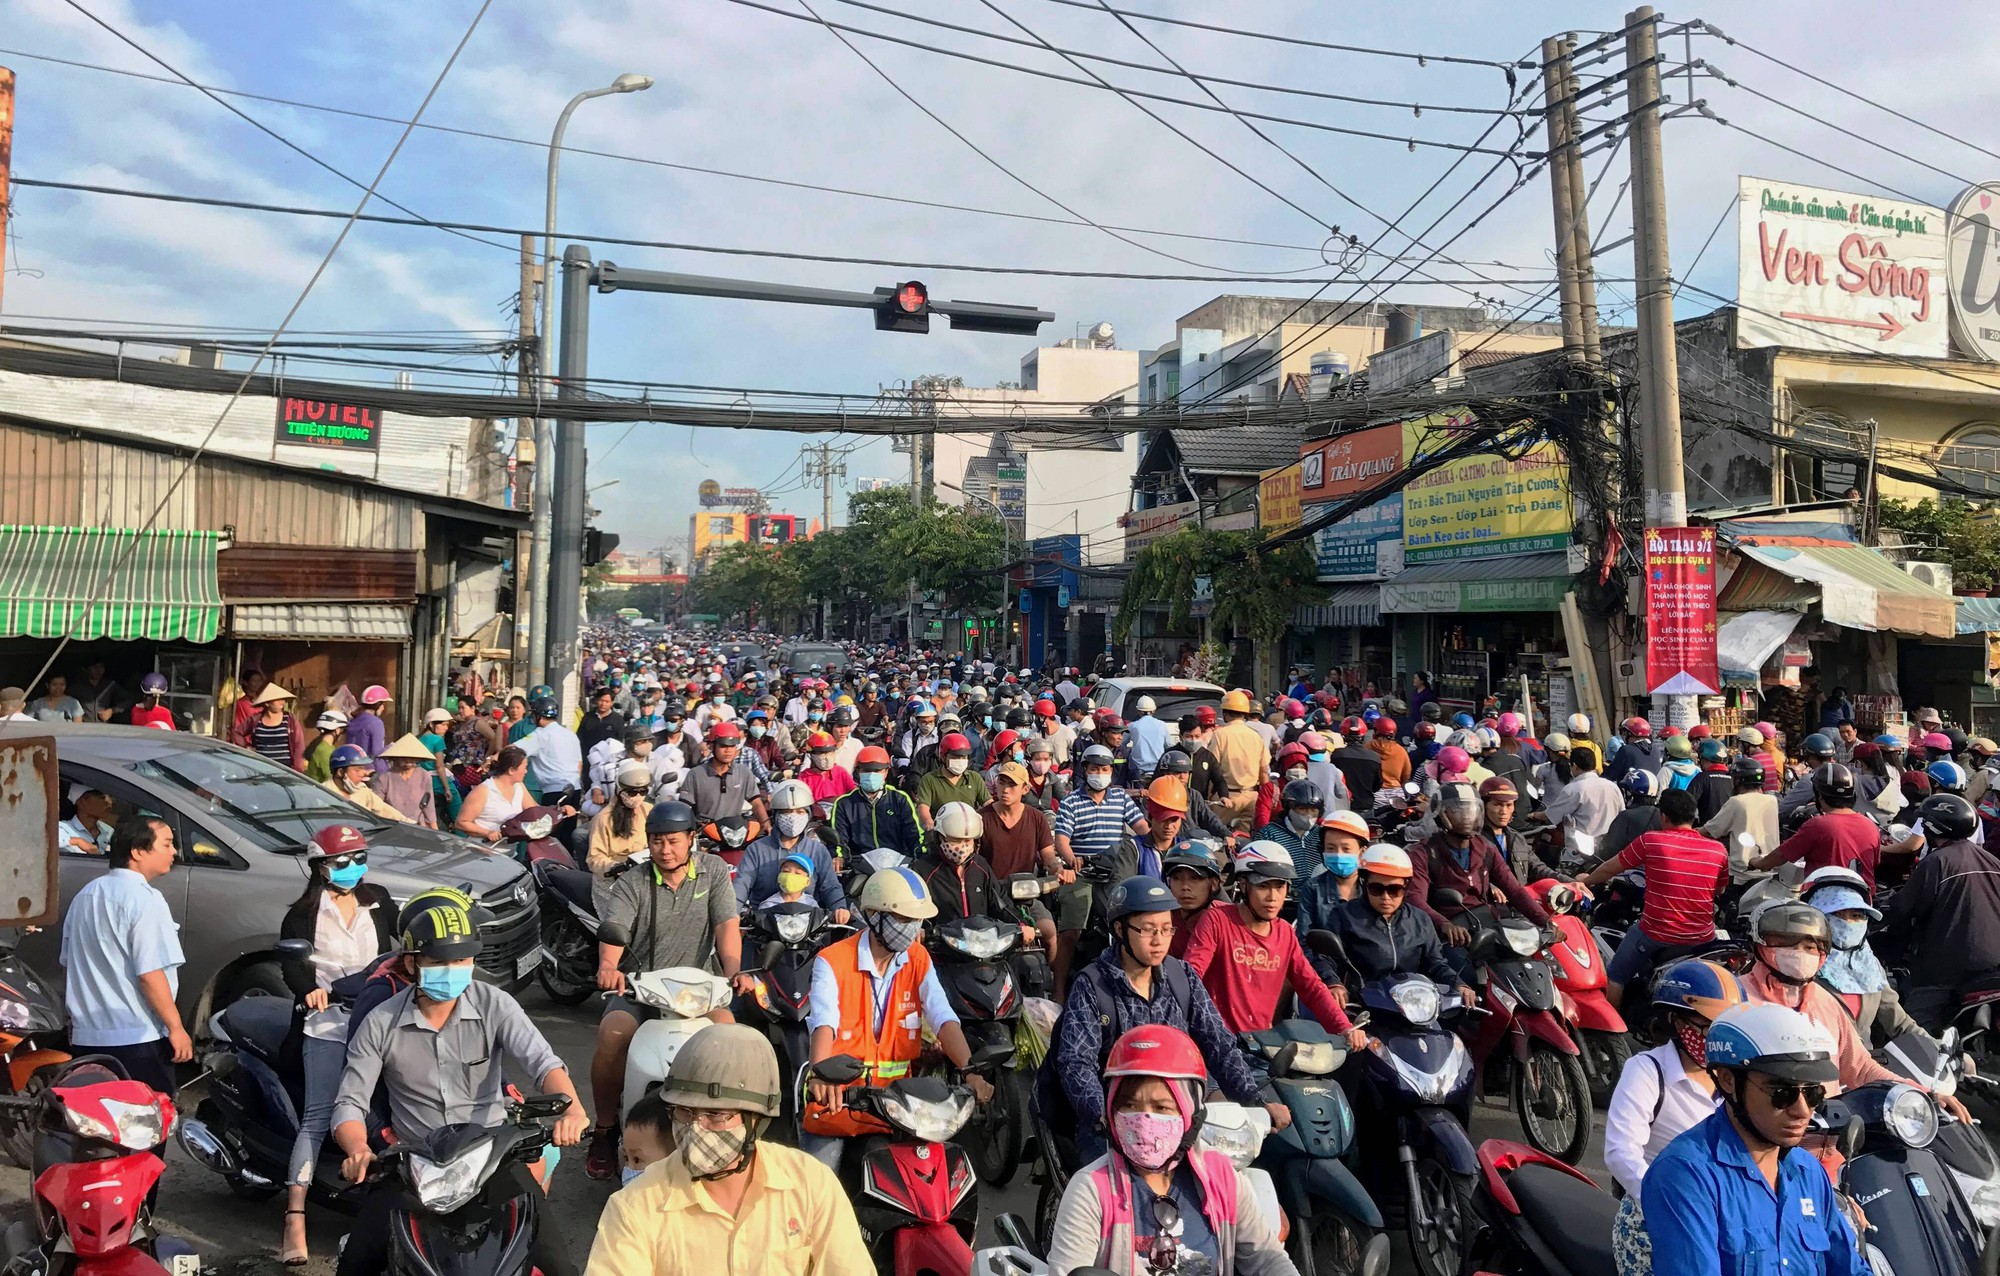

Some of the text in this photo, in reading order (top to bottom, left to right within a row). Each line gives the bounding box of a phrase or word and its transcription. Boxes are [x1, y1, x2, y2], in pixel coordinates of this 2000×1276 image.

[1760, 188, 1791, 213] Quán
[1792, 195, 1804, 215] ăn
[1806, 197, 1825, 218] sân
[1850, 203, 1859, 223] &
[1861, 203, 1881, 227] Câu
[1882, 209, 1895, 229] cá
[1914, 216, 1927, 235] trí
[1758, 221, 1930, 322] Ven Sông
[1330, 456, 1395, 482] TRẦN QUANG
[1408, 497, 1422, 510] Trà
[1446, 490, 1465, 505] Thái
[1468, 484, 1502, 503] Nguyên
[1505, 481, 1524, 494] Tân
[1527, 477, 1560, 493] Cương
[1430, 514, 1448, 525] Sen
[1506, 502, 1526, 515] Trà
[760, 537, 779, 545] Shop
[1434, 531, 1452, 544] Kẹo
[1455, 528, 1470, 540] các
[1649, 537, 1712, 554] HỘI TRẠI 9/1
[1650, 556, 1666, 566] HỌC
[1667, 556, 1686, 564] SINH
[1688, 556, 1705, 566] CỤM
[1661, 626, 1678, 634] LIÊN
[1651, 636, 1668, 644] HỌC
[1690, 636, 1707, 644] CỤM
[1856, 1187, 1893, 1206] Vespa
